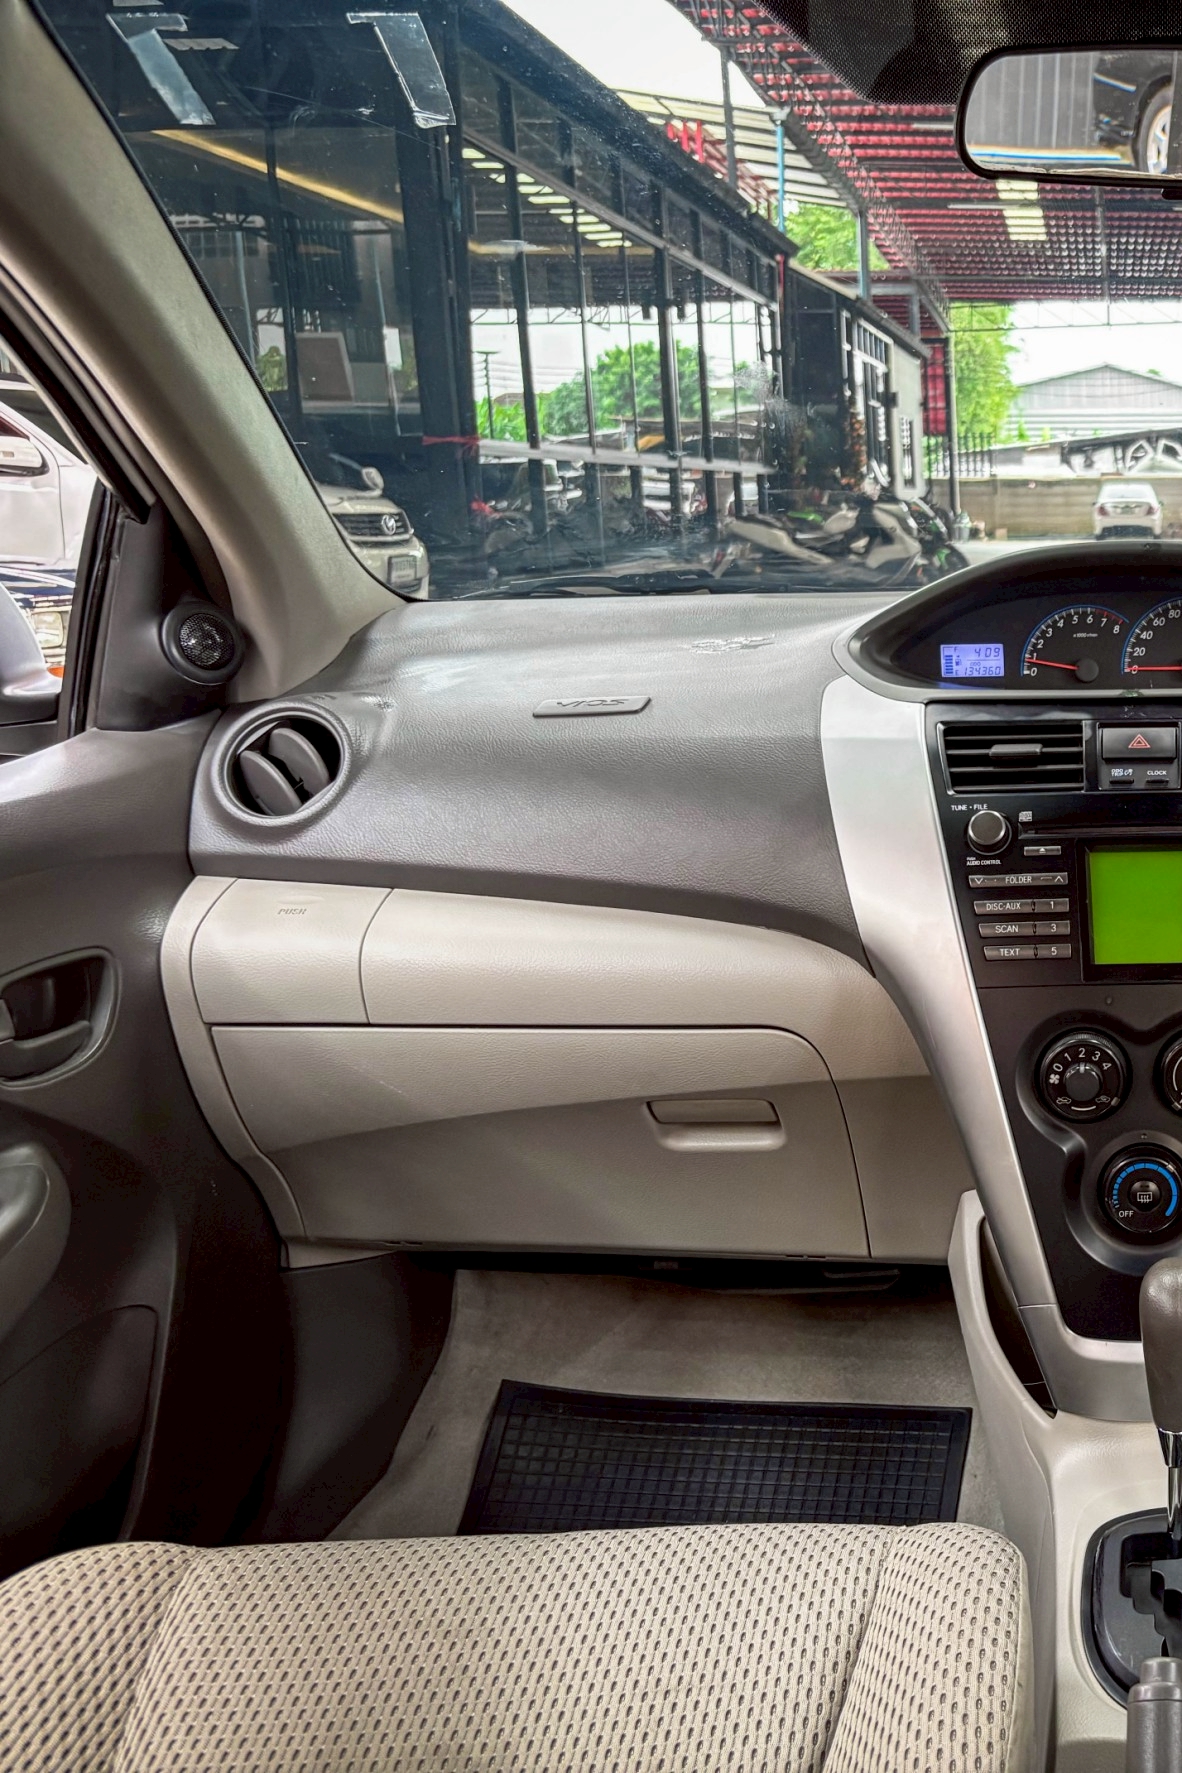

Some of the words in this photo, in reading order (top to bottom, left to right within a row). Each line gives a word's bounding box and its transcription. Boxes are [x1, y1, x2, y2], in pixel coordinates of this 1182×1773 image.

[1168, 609, 1180, 618] 80
[1056, 619, 1064, 628] 4
[1072, 615, 1078, 624] 5
[1087, 614, 1094, 624] 6
[1100, 618, 1108, 627] 7
[1152, 617, 1166, 626] 60
[1046, 628, 1052, 637] 3
[1112, 624, 1120, 634] 8
[1140, 630, 1154, 640] 40
[1037, 639, 1044, 648] 2
[1133, 646, 1146, 656] 20
[1032, 652, 1036, 660] 1
[964, 666, 1002, 676] 134360
[1030, 668, 1038, 676] 0
[1132, 664, 1138, 674] 0
[556, 698, 630, 708] VIOS
[1005, 876, 1032, 884] FOLDER
[1050, 901, 1054, 910] 1
[277, 908, 308, 916] PUSH
[995, 924, 1018, 933] SCAN
[1050, 924, 1057, 932] 3
[1000, 948, 1020, 956] TEXT
[1051, 946, 1058, 956] 5
[1052, 1063, 1063, 1072] 0
[1064, 1052, 1072, 1062] 1
[1078, 1048, 1086, 1058] 2
[1092, 1050, 1100, 1061] 3
[1118, 1210, 1134, 1218] OFF
